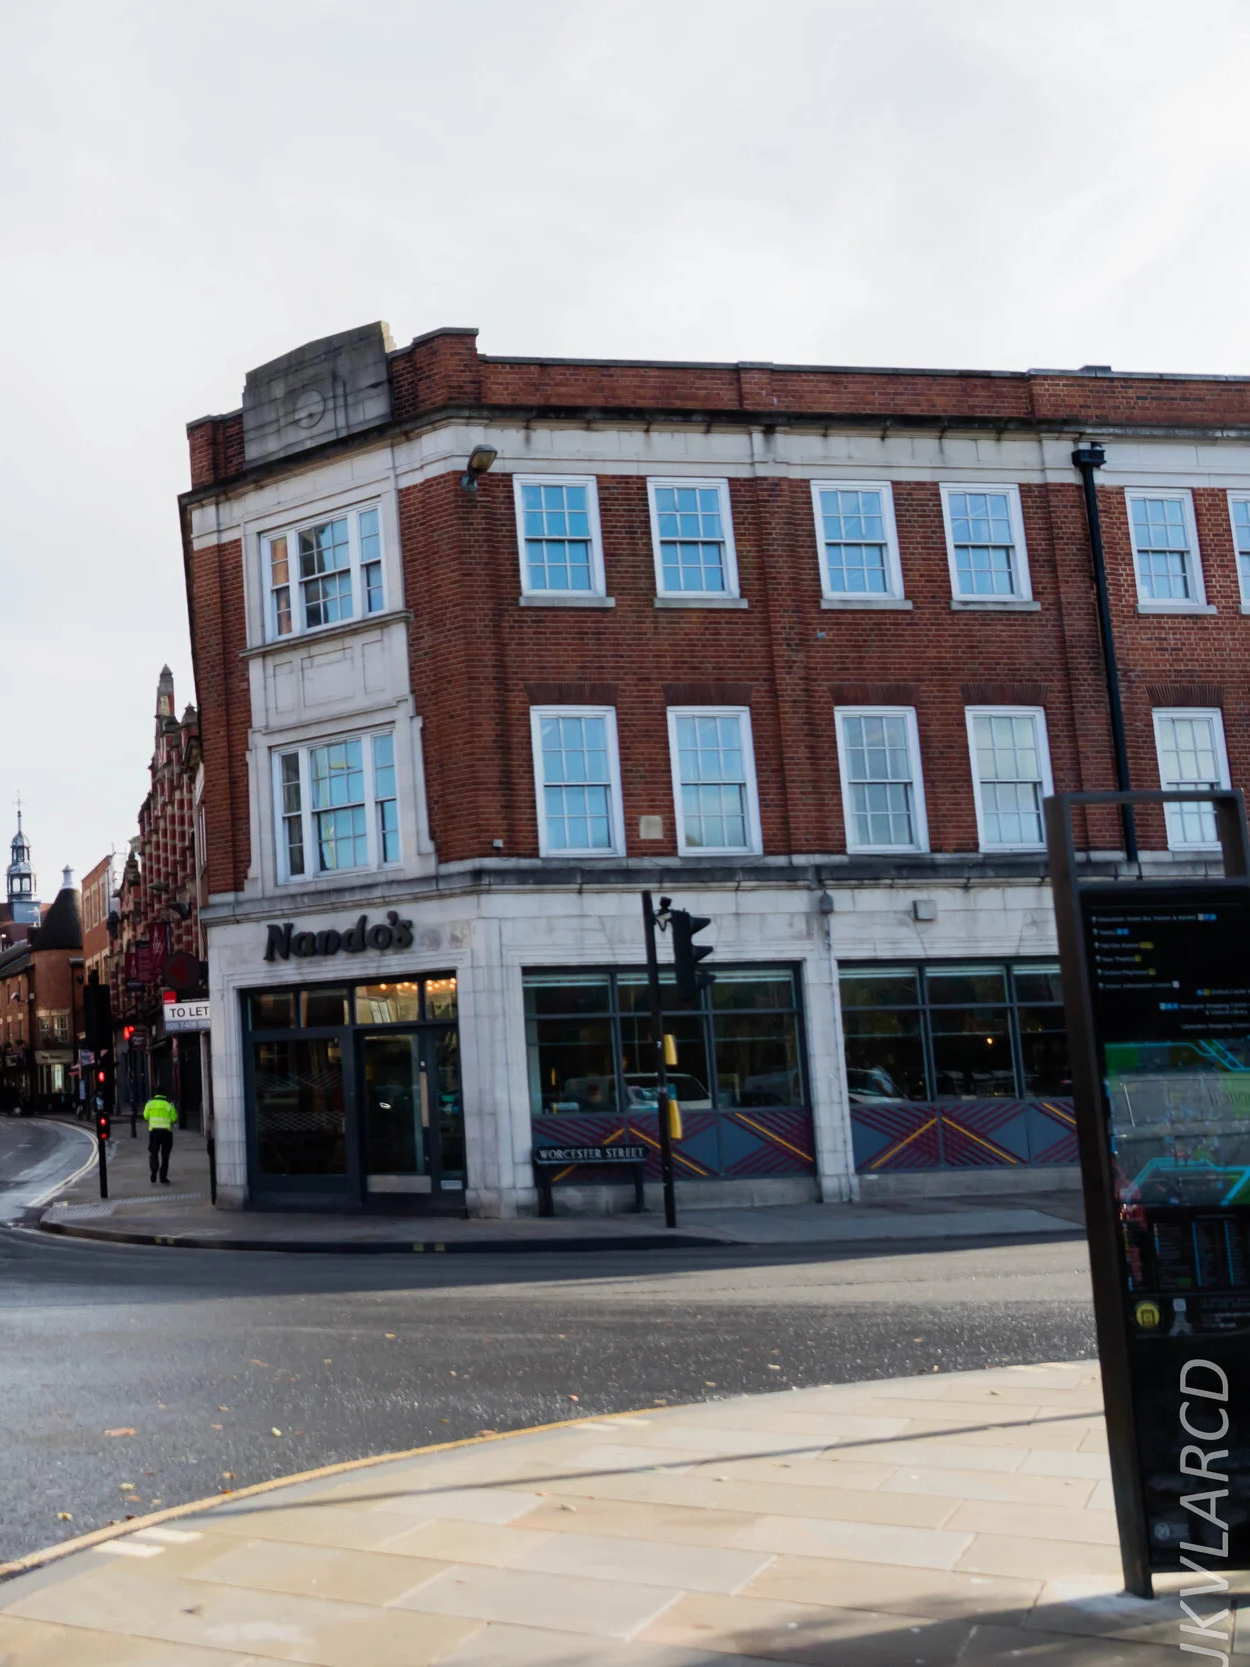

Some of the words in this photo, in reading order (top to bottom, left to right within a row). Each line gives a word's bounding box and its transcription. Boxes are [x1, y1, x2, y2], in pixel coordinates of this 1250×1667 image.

[263, 910, 414, 962] Nando's
[169, 1007, 186, 1018] TO
[189, 1006, 209, 1017] LET
[538, 1147, 602, 1160] WORCESTER
[605, 1147, 644, 1159] STREET
